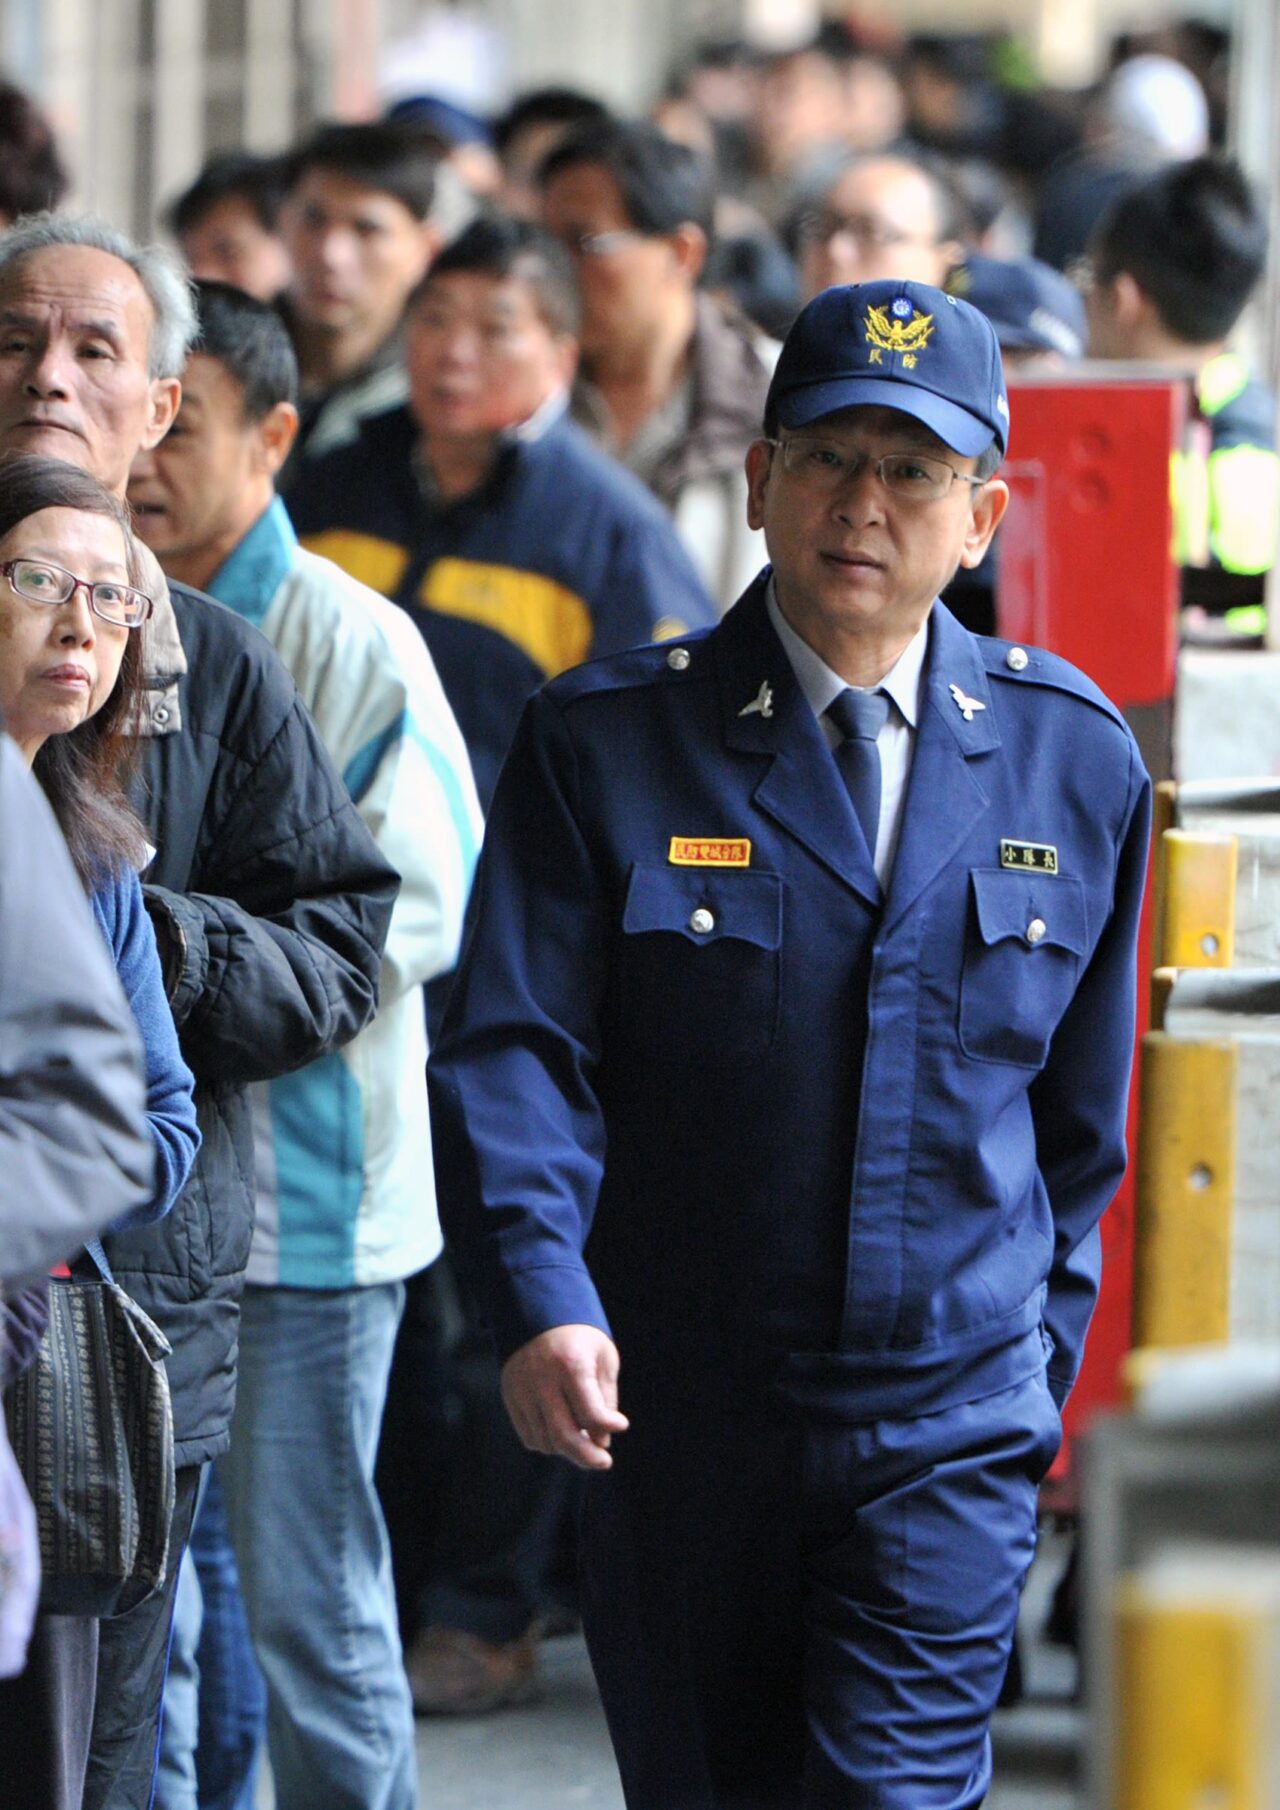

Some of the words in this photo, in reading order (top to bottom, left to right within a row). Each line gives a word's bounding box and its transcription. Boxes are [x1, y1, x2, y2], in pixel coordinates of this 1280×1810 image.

[868, 348, 918, 369] 民防
[1005, 846, 1055, 869] 小隊長
